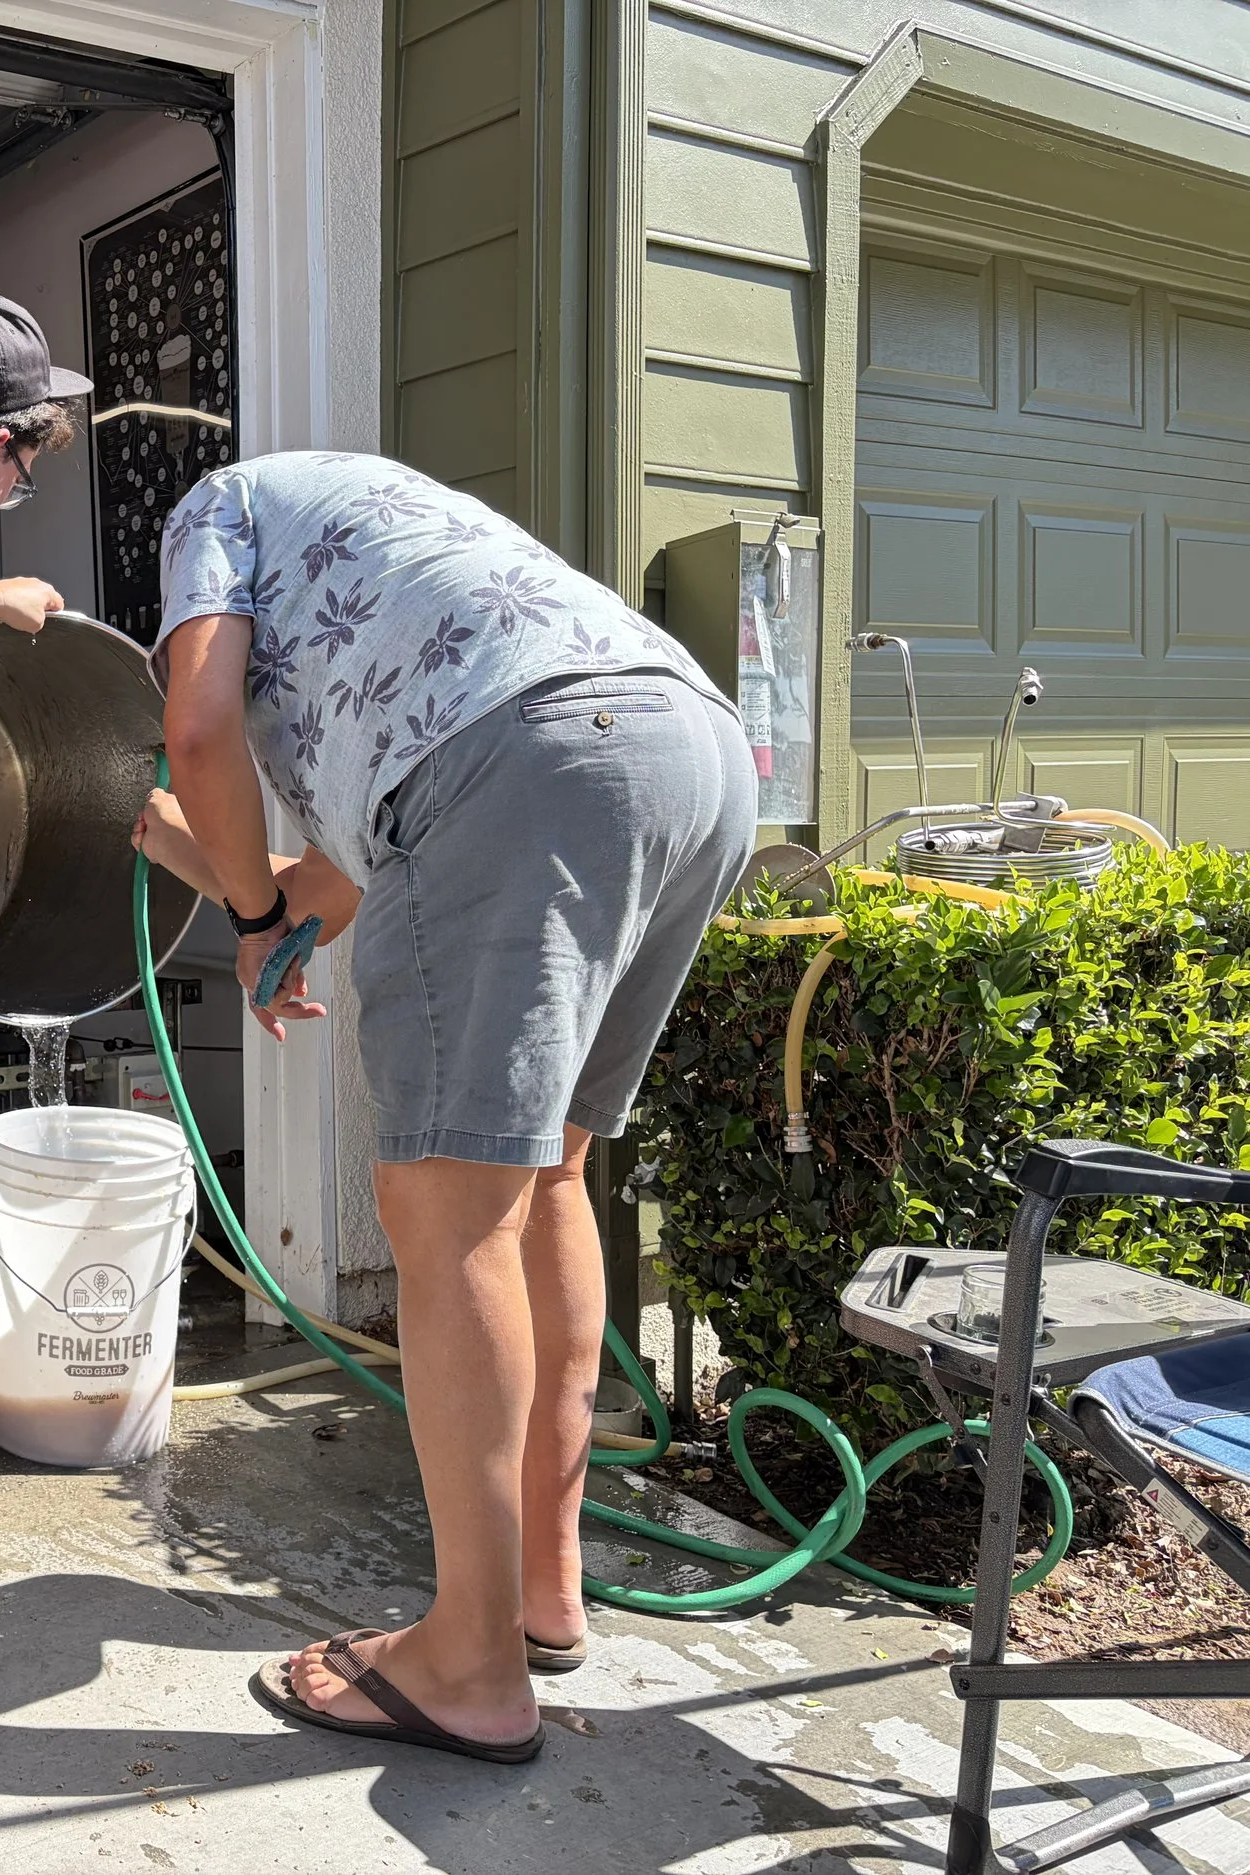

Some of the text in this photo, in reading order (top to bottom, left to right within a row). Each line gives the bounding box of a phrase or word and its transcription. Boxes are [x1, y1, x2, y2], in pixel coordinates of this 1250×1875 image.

[37, 1332, 153, 1361] FERMENTER
[70, 1366, 124, 1376] FOOD GRADE
[72, 1390, 120, 1400] Brewmaster
